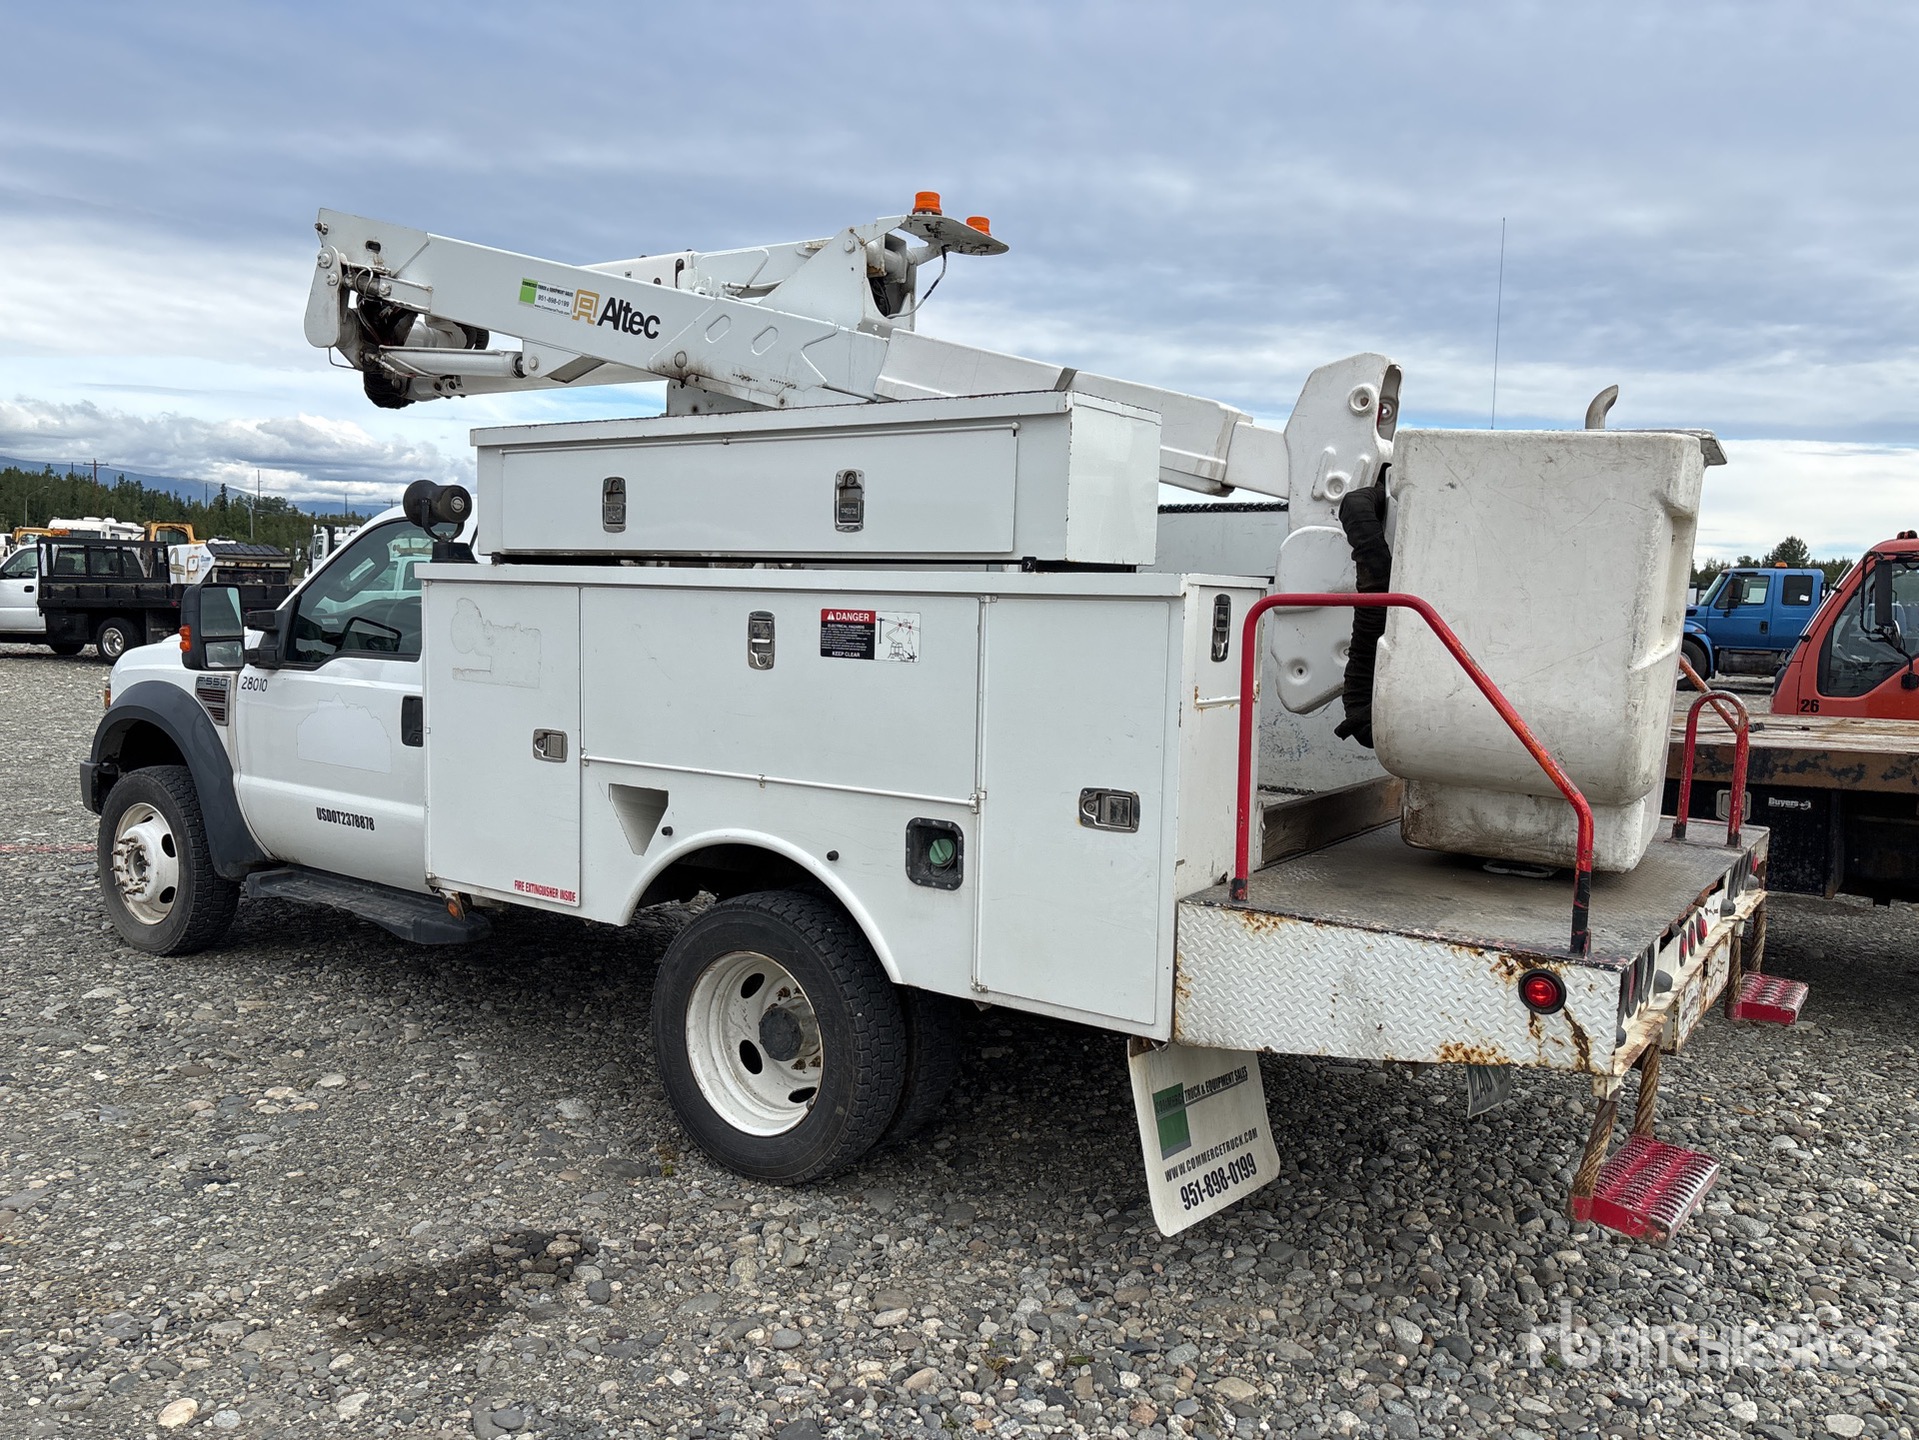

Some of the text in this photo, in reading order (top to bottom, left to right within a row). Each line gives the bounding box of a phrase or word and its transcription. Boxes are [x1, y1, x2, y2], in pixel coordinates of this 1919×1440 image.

[537, 294, 570, 308] 951-898-0199
[597, 297, 661, 340] Altec
[836, 612, 869, 622] DANGER
[197, 676, 228, 687] F-550
[241, 676, 268, 692] 28010
[1799, 698, 1820, 713] 26
[1767, 796, 1799, 809] Buyers
[315, 806, 375, 832] USDOT2378878
[514, 880, 576, 902] FIRE EXTINGUISHER INSIDE
[1184, 1083, 1201, 1103] TRUCK
[1205, 1072, 1234, 1093] EQUIPMENT
[1234, 1065, 1249, 1081] SALES
[1164, 1127, 1259, 1183] WWW.COMMERCETRUCK.COM
[1180, 1151, 1258, 1211] 951-898-0199
